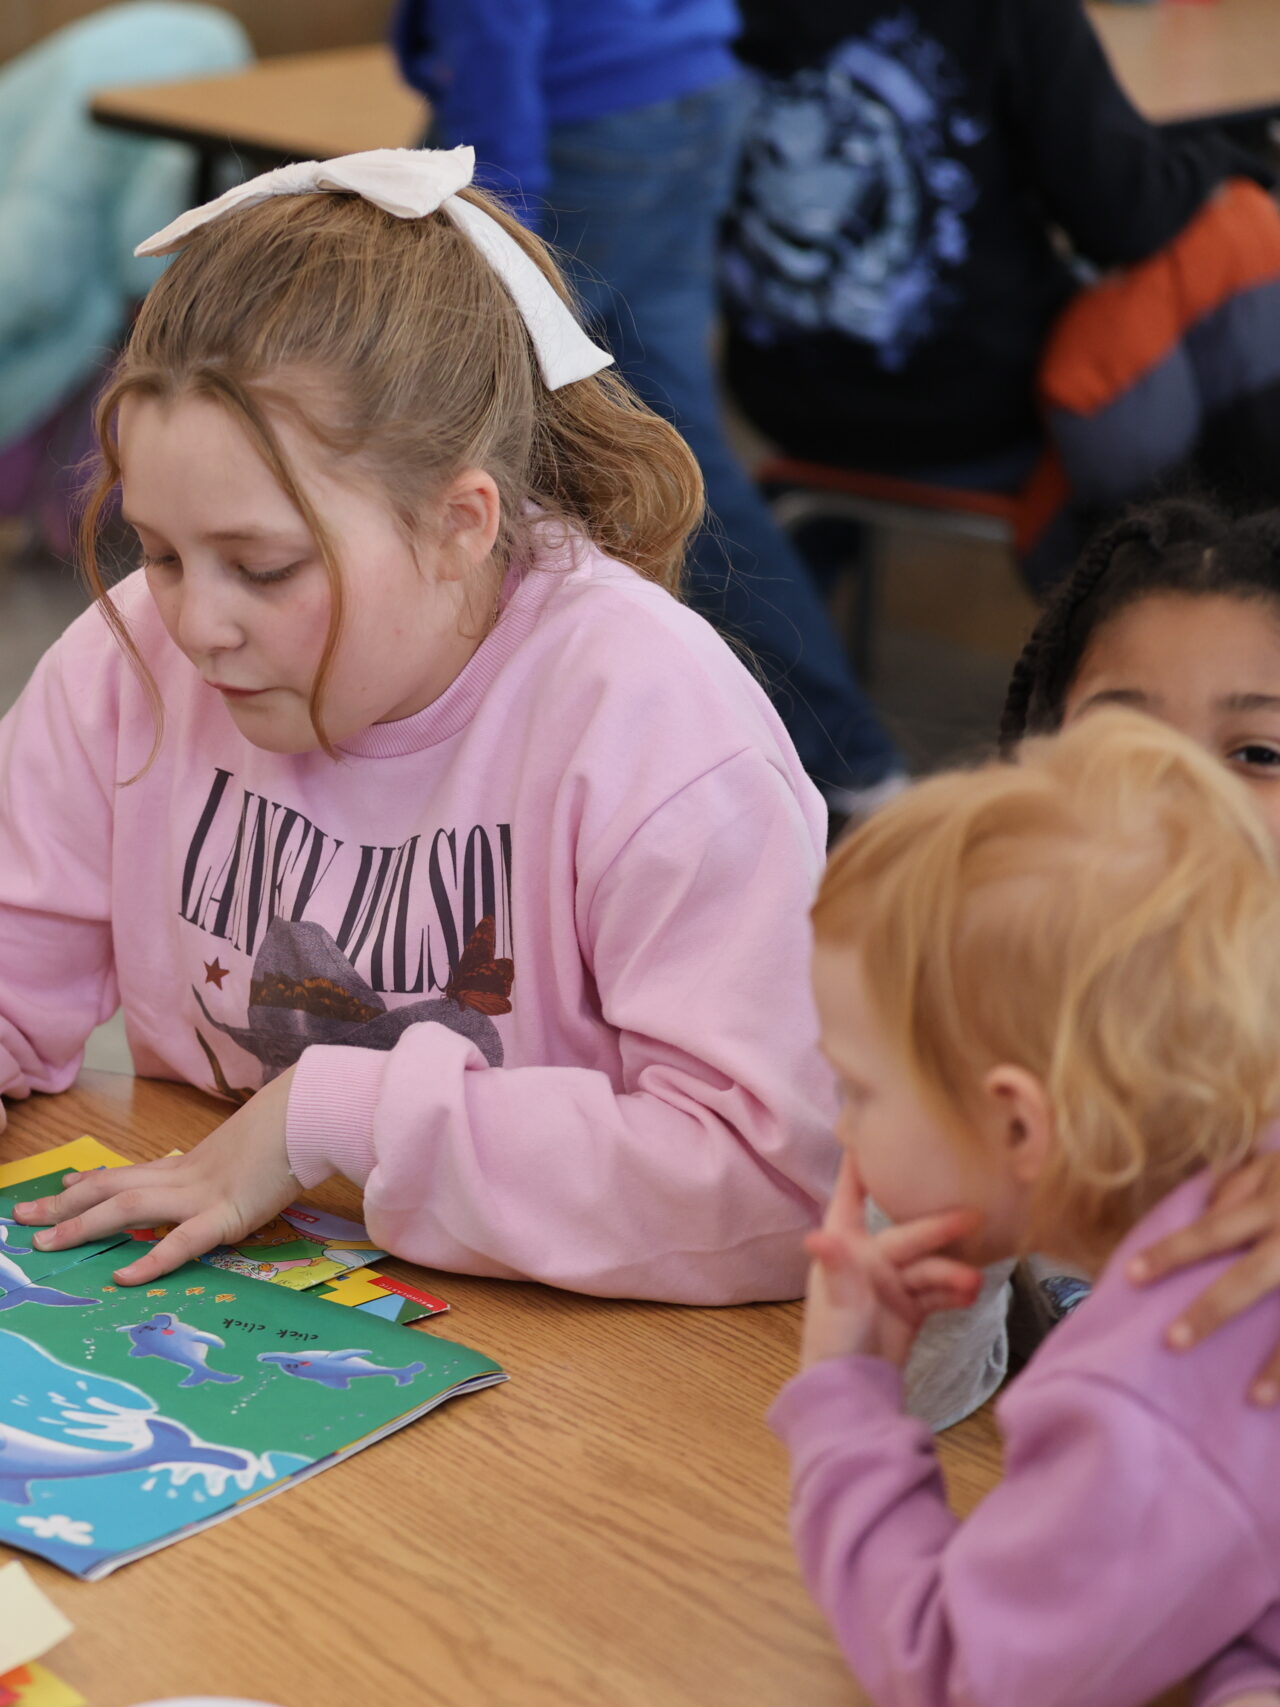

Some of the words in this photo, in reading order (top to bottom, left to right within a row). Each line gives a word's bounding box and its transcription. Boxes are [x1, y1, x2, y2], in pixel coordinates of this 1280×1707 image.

[178, 767, 344, 956] LANEY
[222, 1318, 266, 1333] click
[276, 1329, 319, 1341] click
